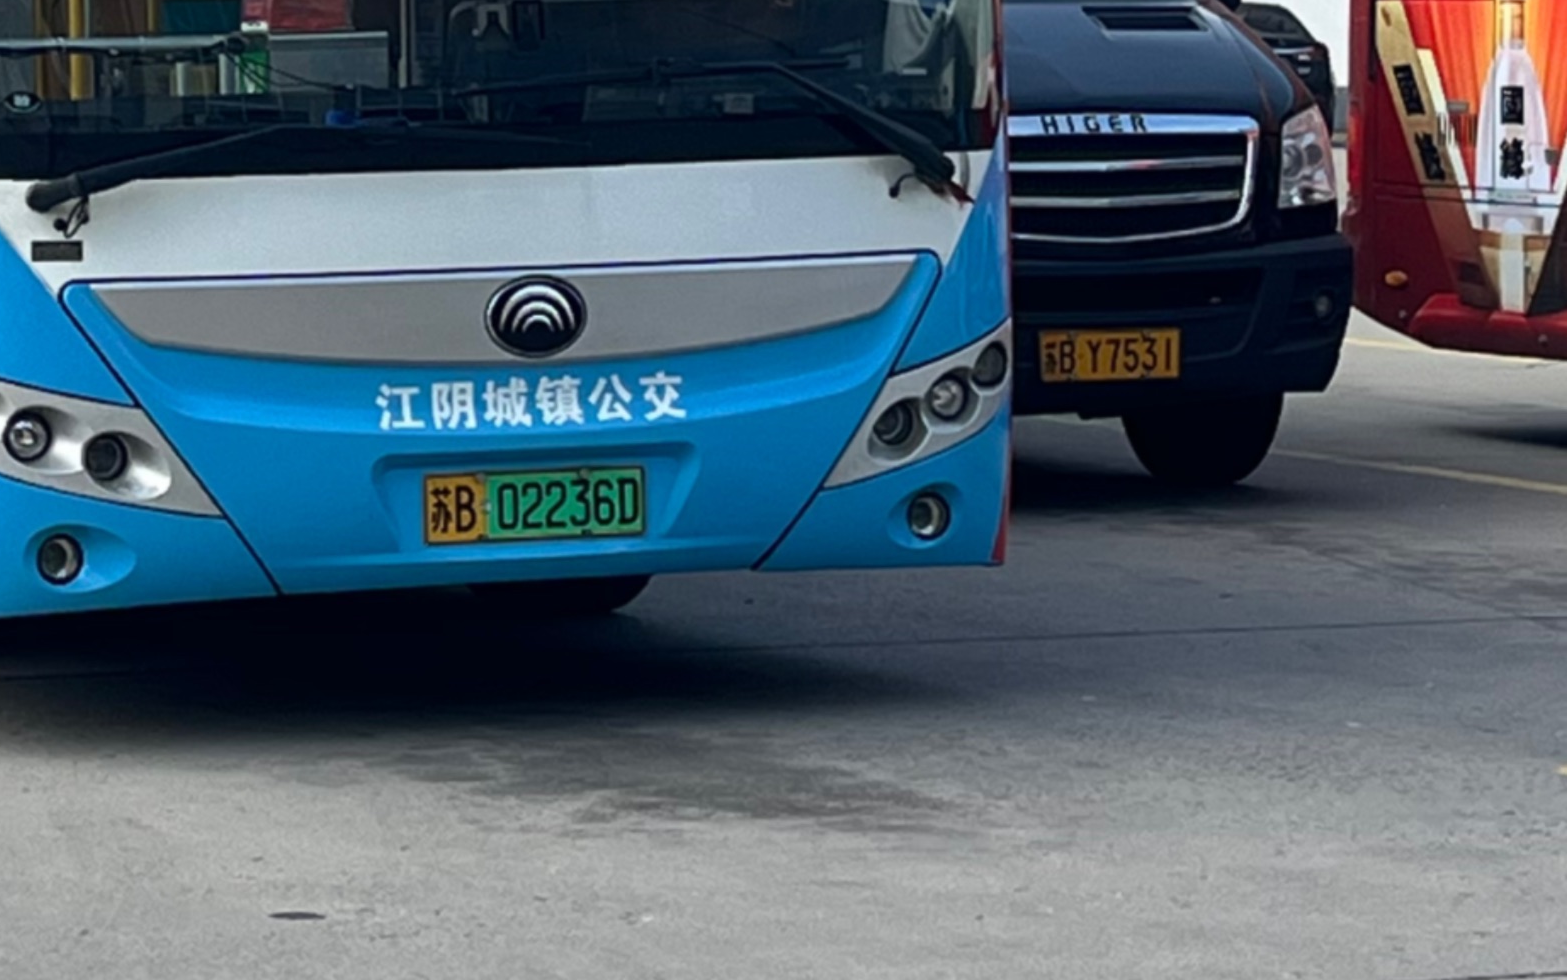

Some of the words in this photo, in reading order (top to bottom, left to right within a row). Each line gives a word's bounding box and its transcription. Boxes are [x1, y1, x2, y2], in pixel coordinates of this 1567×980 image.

[1039, 113, 1149, 134] HIGER
[1086, 337, 1172, 372] Y7531
[375, 370, 687, 431] 江阴城镇公交
[430, 485, 477, 534] 苏B
[496, 477, 640, 531] 02236D
